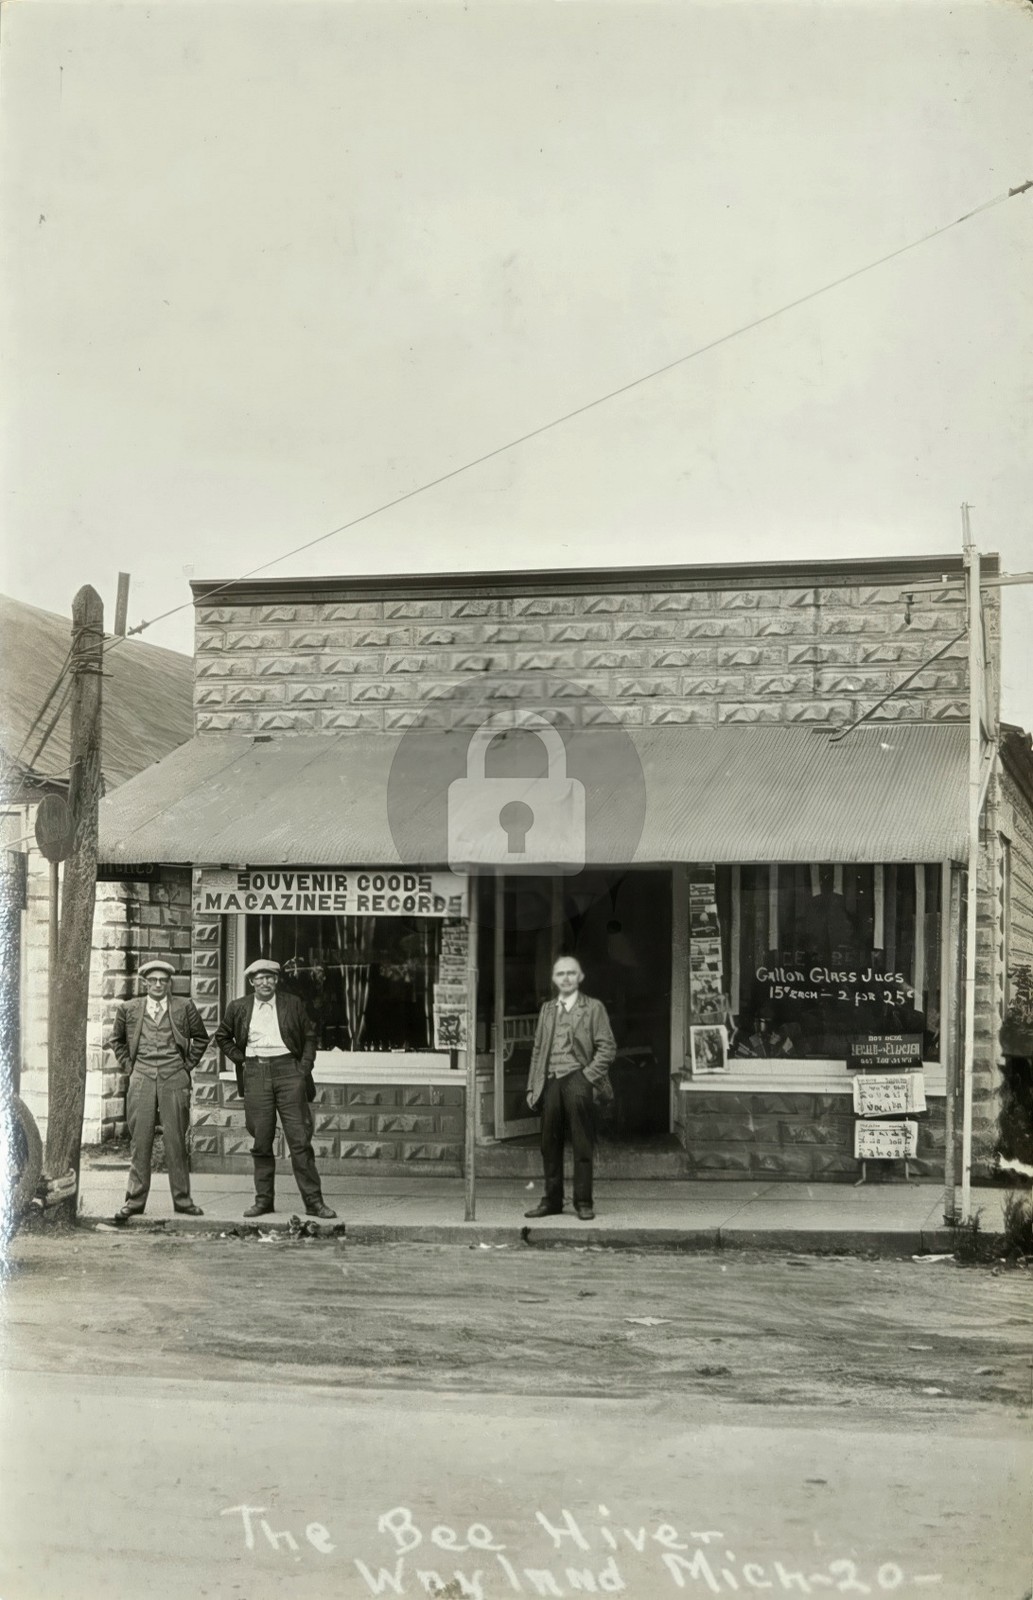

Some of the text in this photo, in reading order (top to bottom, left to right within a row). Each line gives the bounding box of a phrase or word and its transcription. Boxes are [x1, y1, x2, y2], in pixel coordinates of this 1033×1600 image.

[237, 873, 347, 891] SOUVENIR
[356, 893, 462, 913] RECORDS
[838, 990, 851, 1001] 2
[224, 1504, 337, 1554] The
[377, 1505, 508, 1553] Bee
